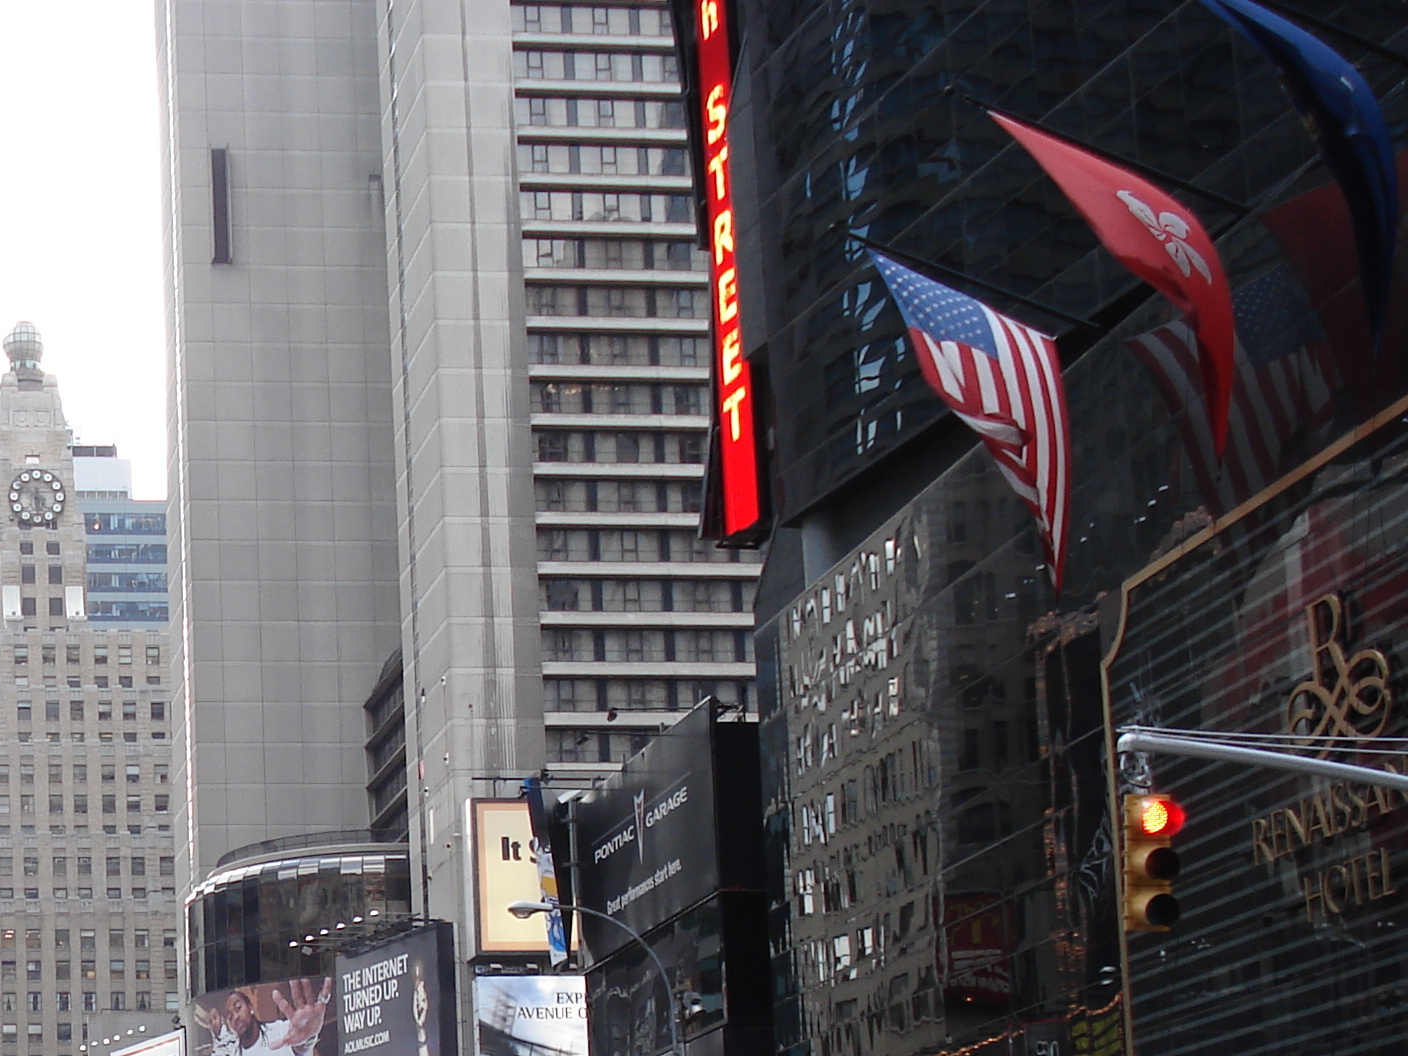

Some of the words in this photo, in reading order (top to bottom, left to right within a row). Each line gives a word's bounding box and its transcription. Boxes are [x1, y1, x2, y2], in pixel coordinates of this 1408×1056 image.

[706, 84, 746, 442] STREET
[645, 786, 689, 829] GARAGE
[501, 836, 522, 862] It
[594, 825, 636, 865] PONTIAC
[1303, 847, 1401, 923] HOTEL
[343, 970, 362, 993] THE
[362, 953, 409, 988] INTERNET
[343, 984, 382, 1014] TURNED
[383, 979, 400, 1001] UP.
[517, 1007, 574, 1020] AVENUE
[344, 1012, 365, 1034] WAY
[366, 1006, 383, 1028] UP.
